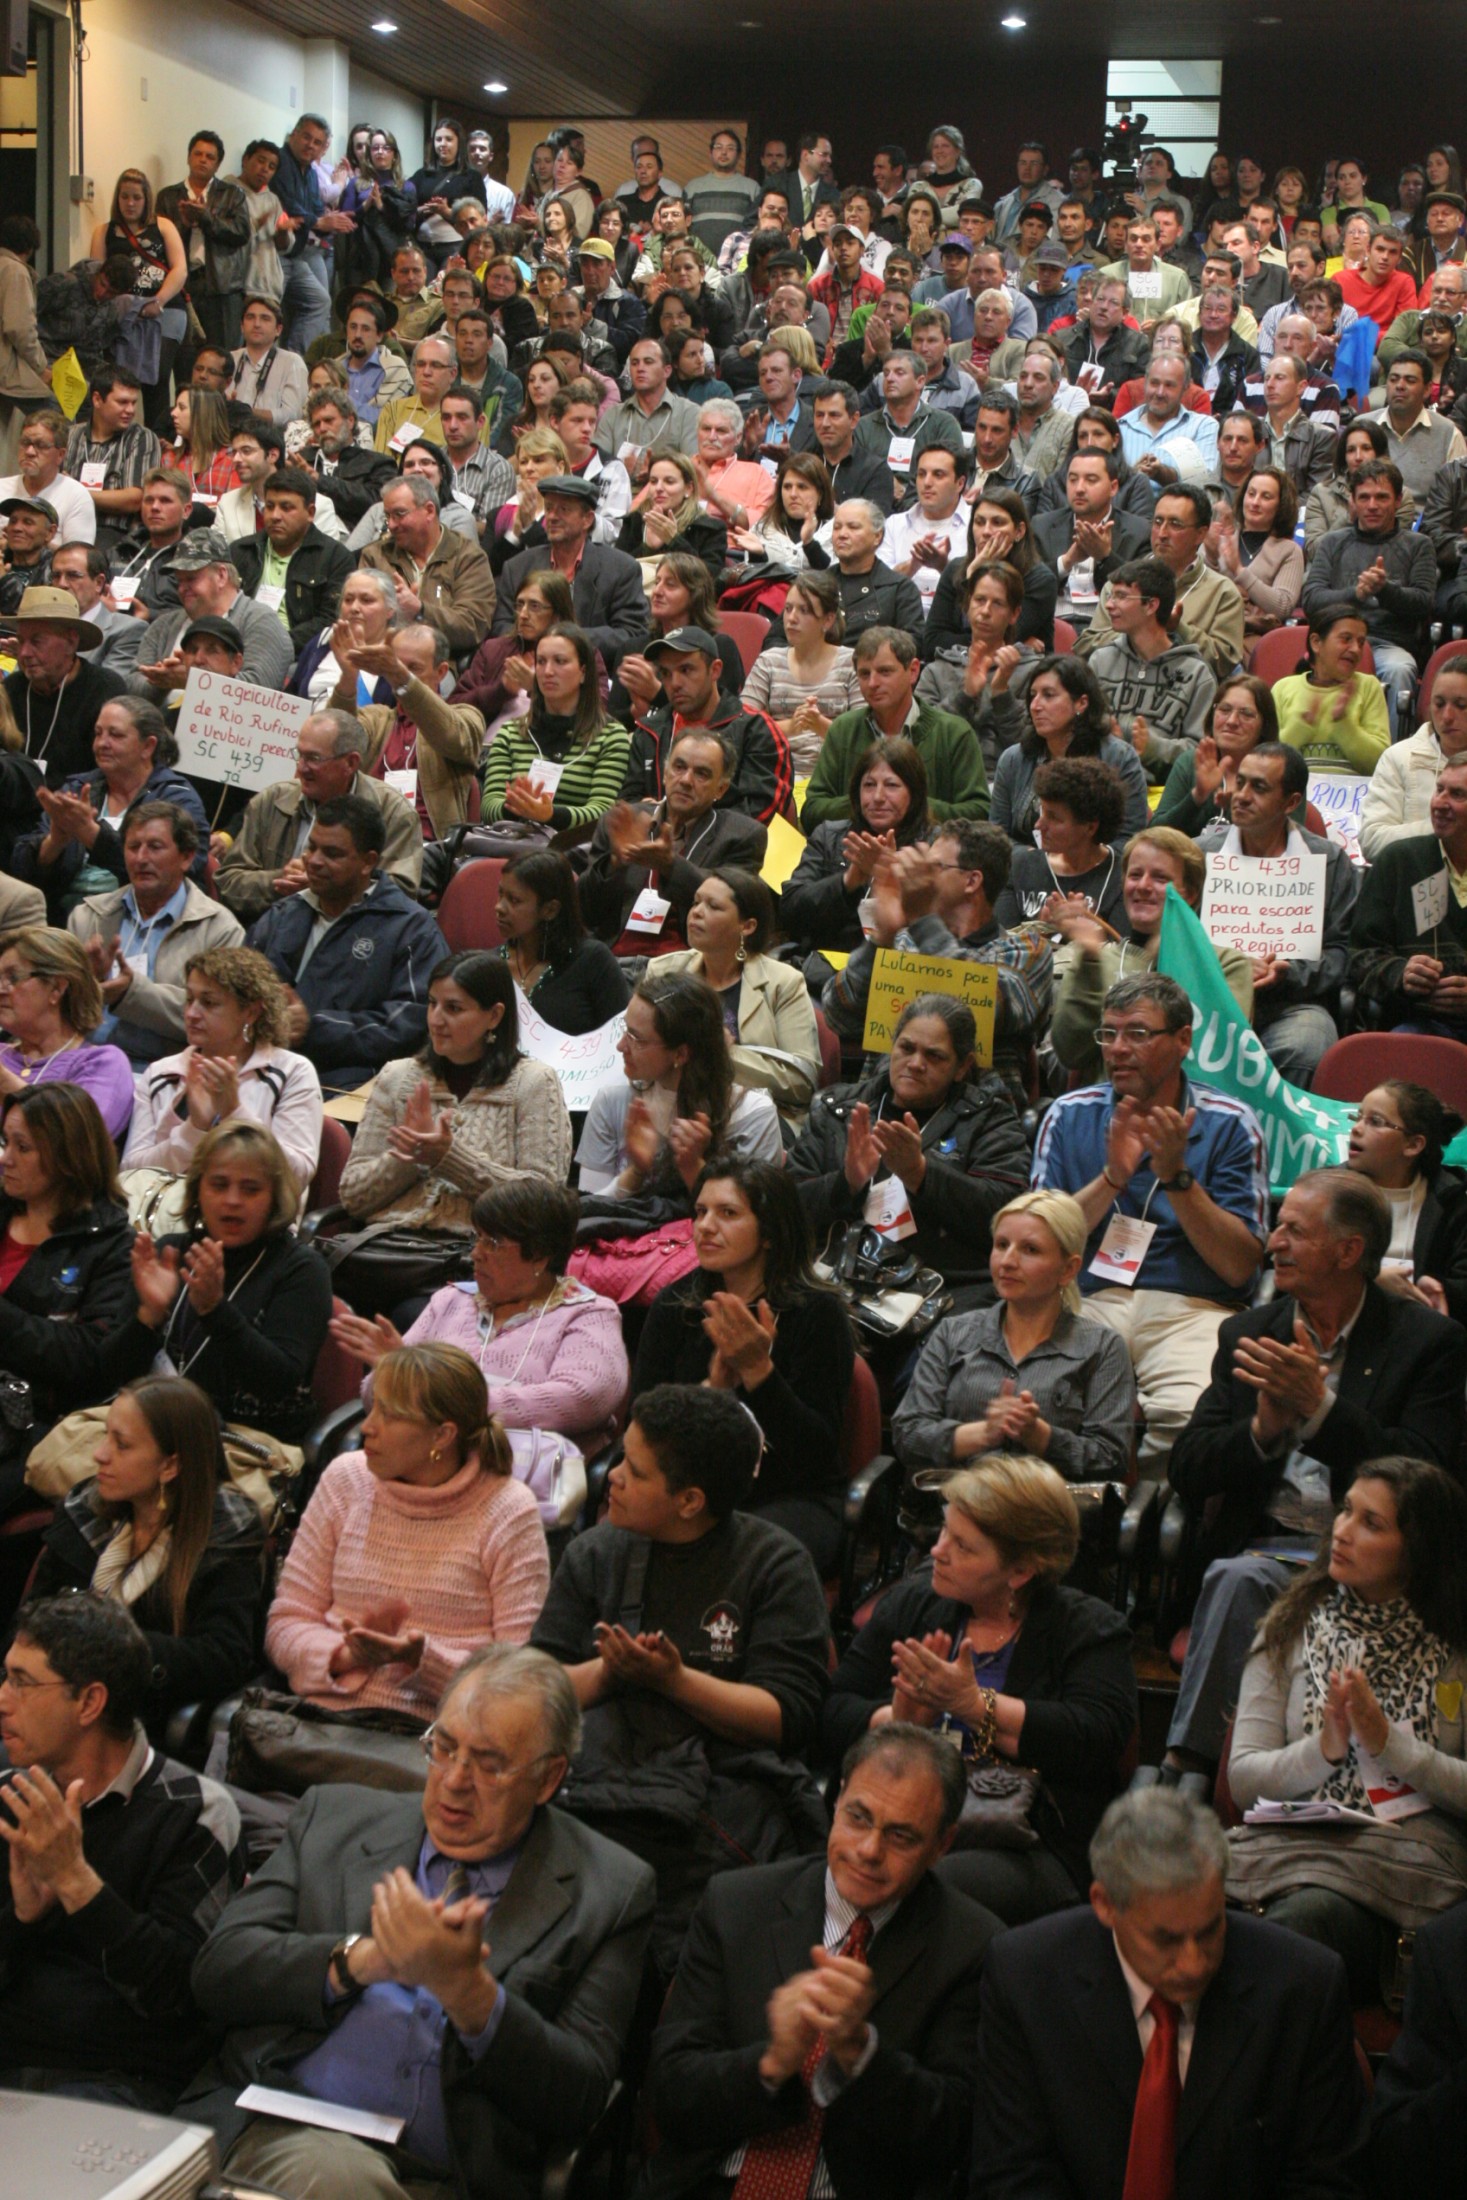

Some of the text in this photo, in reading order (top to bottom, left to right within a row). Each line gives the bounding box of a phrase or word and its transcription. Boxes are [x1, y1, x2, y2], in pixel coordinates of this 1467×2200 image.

[1135, 272, 1153, 284] SC
[1134, 286, 1159, 298] 439
[198, 672, 300, 715] O agricultor
[193, 700, 300, 739] de Rio Rufino
[189, 722, 296, 761] e Urubici precis
[194, 740, 264, 773] SC 439
[1311, 782, 1369, 816] RIO R
[1212, 855, 1300, 876] SC 439
[1208, 877, 1316, 898] PRIORIDADE
[1417, 876, 1439, 903] SC
[1210, 903, 1314, 917] para escoar
[1211, 921, 1317, 937] produtos da
[880, 950, 990, 988] Lutamos por
[875, 981, 905, 995] uma
[519, 1001, 546, 1041] SC
[556, 1054, 616, 1082] OMISSO
